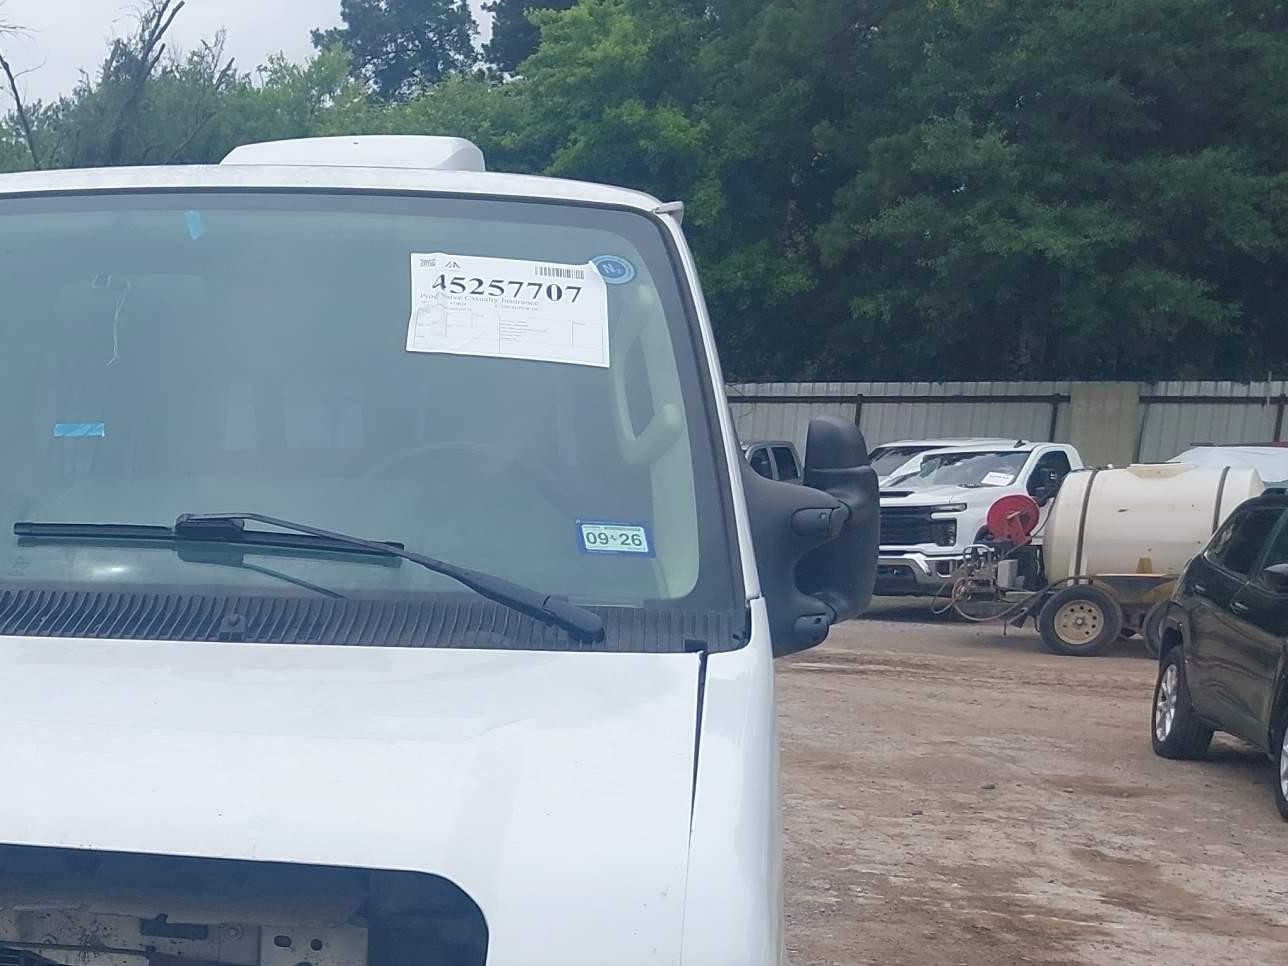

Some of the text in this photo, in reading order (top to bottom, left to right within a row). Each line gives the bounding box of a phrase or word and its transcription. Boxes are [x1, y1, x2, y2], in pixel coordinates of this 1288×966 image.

[431, 273, 583, 303] 45257707
[585, 531, 643, 547] 09 26
